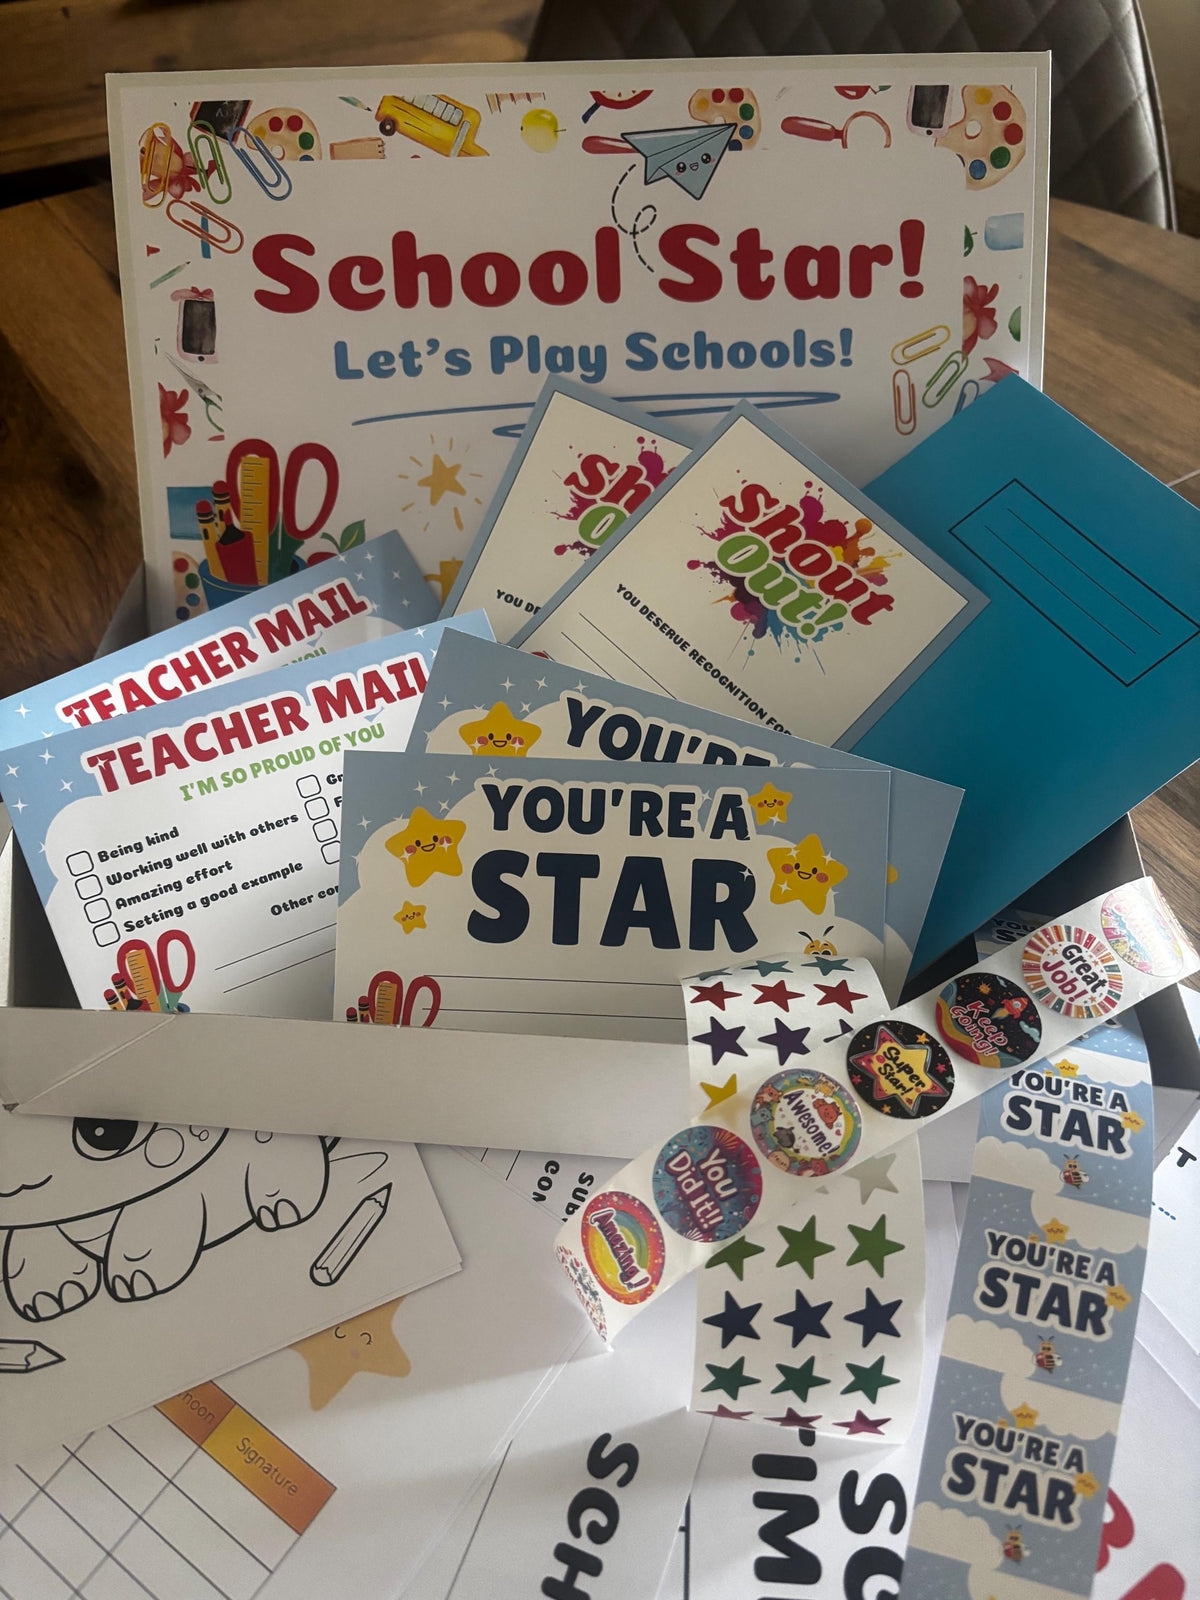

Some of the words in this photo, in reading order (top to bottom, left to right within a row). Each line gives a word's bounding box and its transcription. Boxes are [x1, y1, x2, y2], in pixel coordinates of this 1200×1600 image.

[252, 226, 621, 314] School
[658, 219, 925, 303] Star!
[490, 335, 608, 383] Play
[625, 328, 854, 372] Schools!
[496, 589, 524, 608] YOU
[62, 631, 259, 725] TEACHER
[254, 581, 368, 653] MAIL
[616, 583, 641, 608] YOU
[688, 648, 768, 720] RECOGNITION
[87, 696, 310, 793] TEACHER
[311, 657, 428, 724] MAIL
[179, 776, 219, 801] I'M
[220, 767, 247, 788] SO
[249, 746, 315, 778] PROUD
[320, 736, 343, 756] OF
[343, 722, 386, 749] YOU
[481, 783, 695, 839] YOU'RE
[709, 787, 750, 841] A
[97, 839, 144, 863] Being
[146, 826, 180, 847] kind
[106, 857, 173, 886] Working
[175, 843, 208, 862] well
[211, 831, 246, 851] with
[249, 814, 299, 837] others
[115, 879, 183, 910] Amazing
[186, 860, 234, 884] effort
[124, 904, 184, 932] Setting
[187, 899, 198, 911] a
[200, 883, 238, 909] good
[241, 862, 304, 891] example
[270, 895, 314, 916] Other
[466, 850, 759, 953] STAR
[1042, 960, 1088, 1002] Job!
[1061, 944, 1108, 993] Great
[950, 1005, 999, 1056] Going!
[967, 1001, 1008, 1046] Keep
[878, 1063, 914, 1096] Star!
[883, 1047, 926, 1088] Super
[1006, 1095, 1127, 1154] STAR
[1108, 1093, 1129, 1112] A
[668, 1151, 704, 1195] Did
[700, 1148, 738, 1198] You
[591, 1208, 650, 1290] Amazing!
[988, 1231, 1090, 1280] YOU'RE
[1095, 1262, 1115, 1286] A
[979, 1266, 1110, 1336] STAR
[178, 1391, 216, 1424] noon
[236, 1437, 299, 1496] Signature
[956, 1415, 1060, 1466] YOU'RE
[1065, 1448, 1084, 1473] A
[947, 1452, 1079, 1525] STAR
